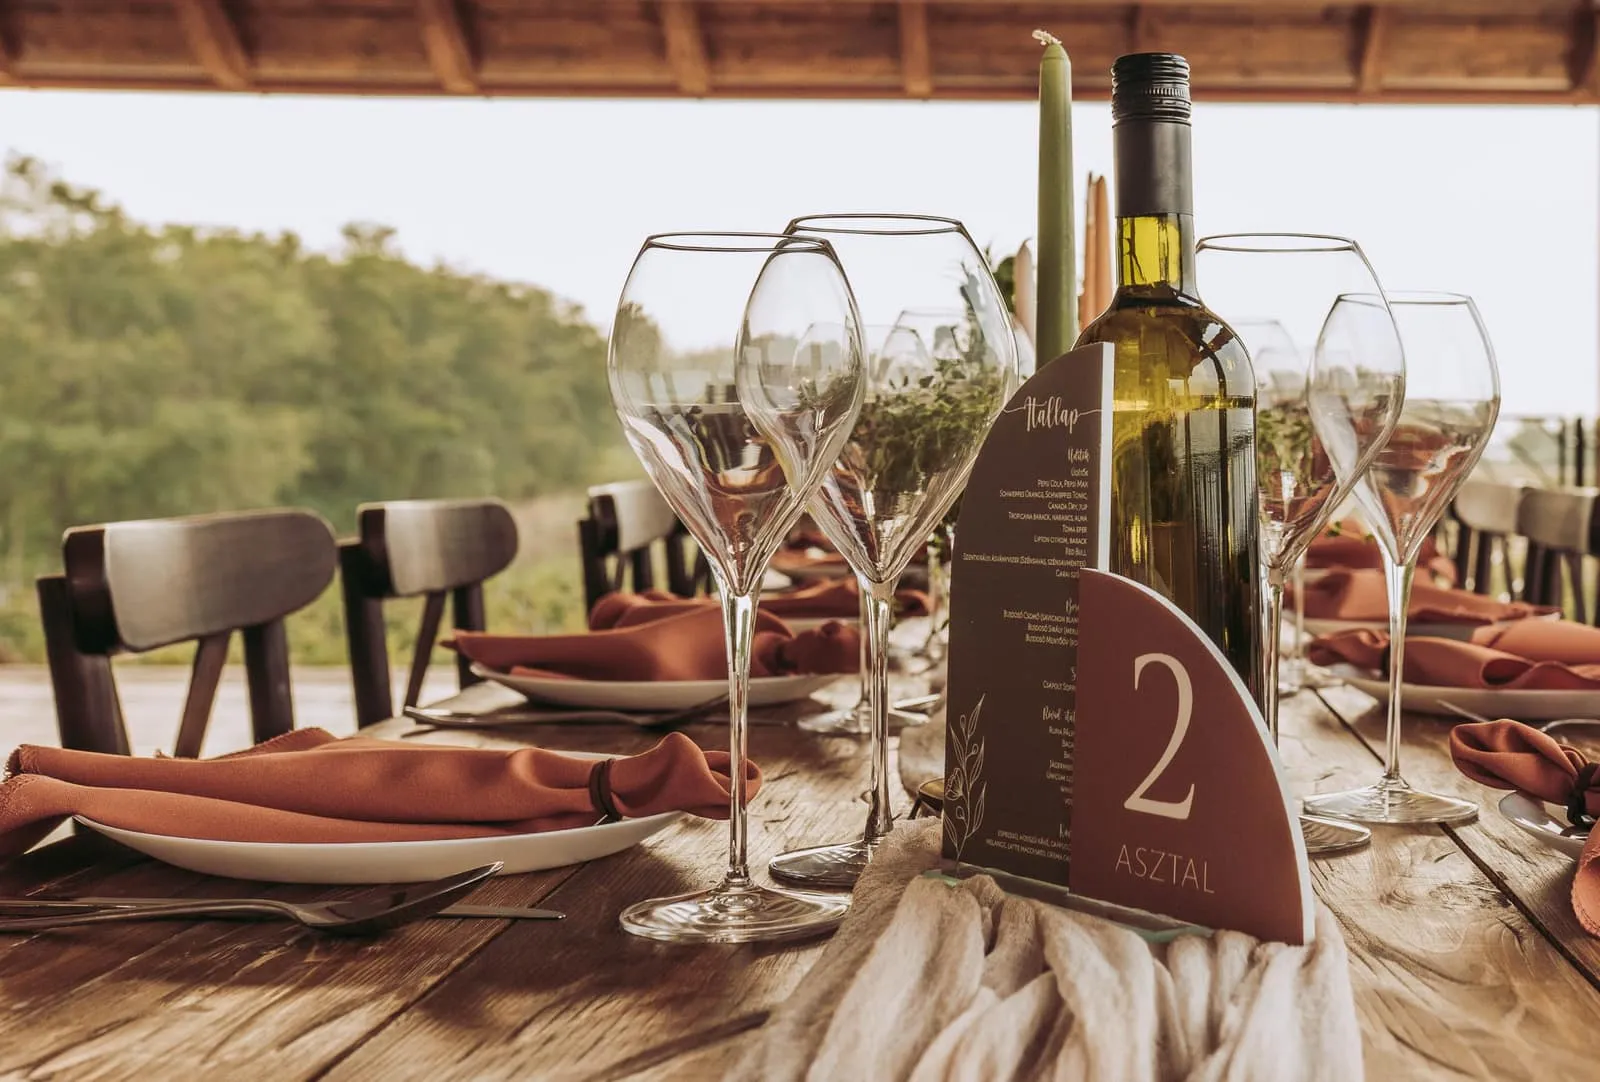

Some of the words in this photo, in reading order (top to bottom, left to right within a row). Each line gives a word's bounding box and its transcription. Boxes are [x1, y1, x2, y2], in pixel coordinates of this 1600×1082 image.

[1020, 396, 1082, 434] Itallap
[1037, 479, 1049, 488] PEPSI
[1077, 480, 1088, 488] MAX
[1048, 502, 1067, 510] CANADA
[1008, 511, 1032, 520] TROPICANA
[1033, 534, 1050, 543] LIPTON
[1065, 547, 1074, 556] RED
[1075, 547, 1087, 557] BULL
[1124, 652, 1195, 820] 2
[1115, 844, 1215, 894] ASZTAL
